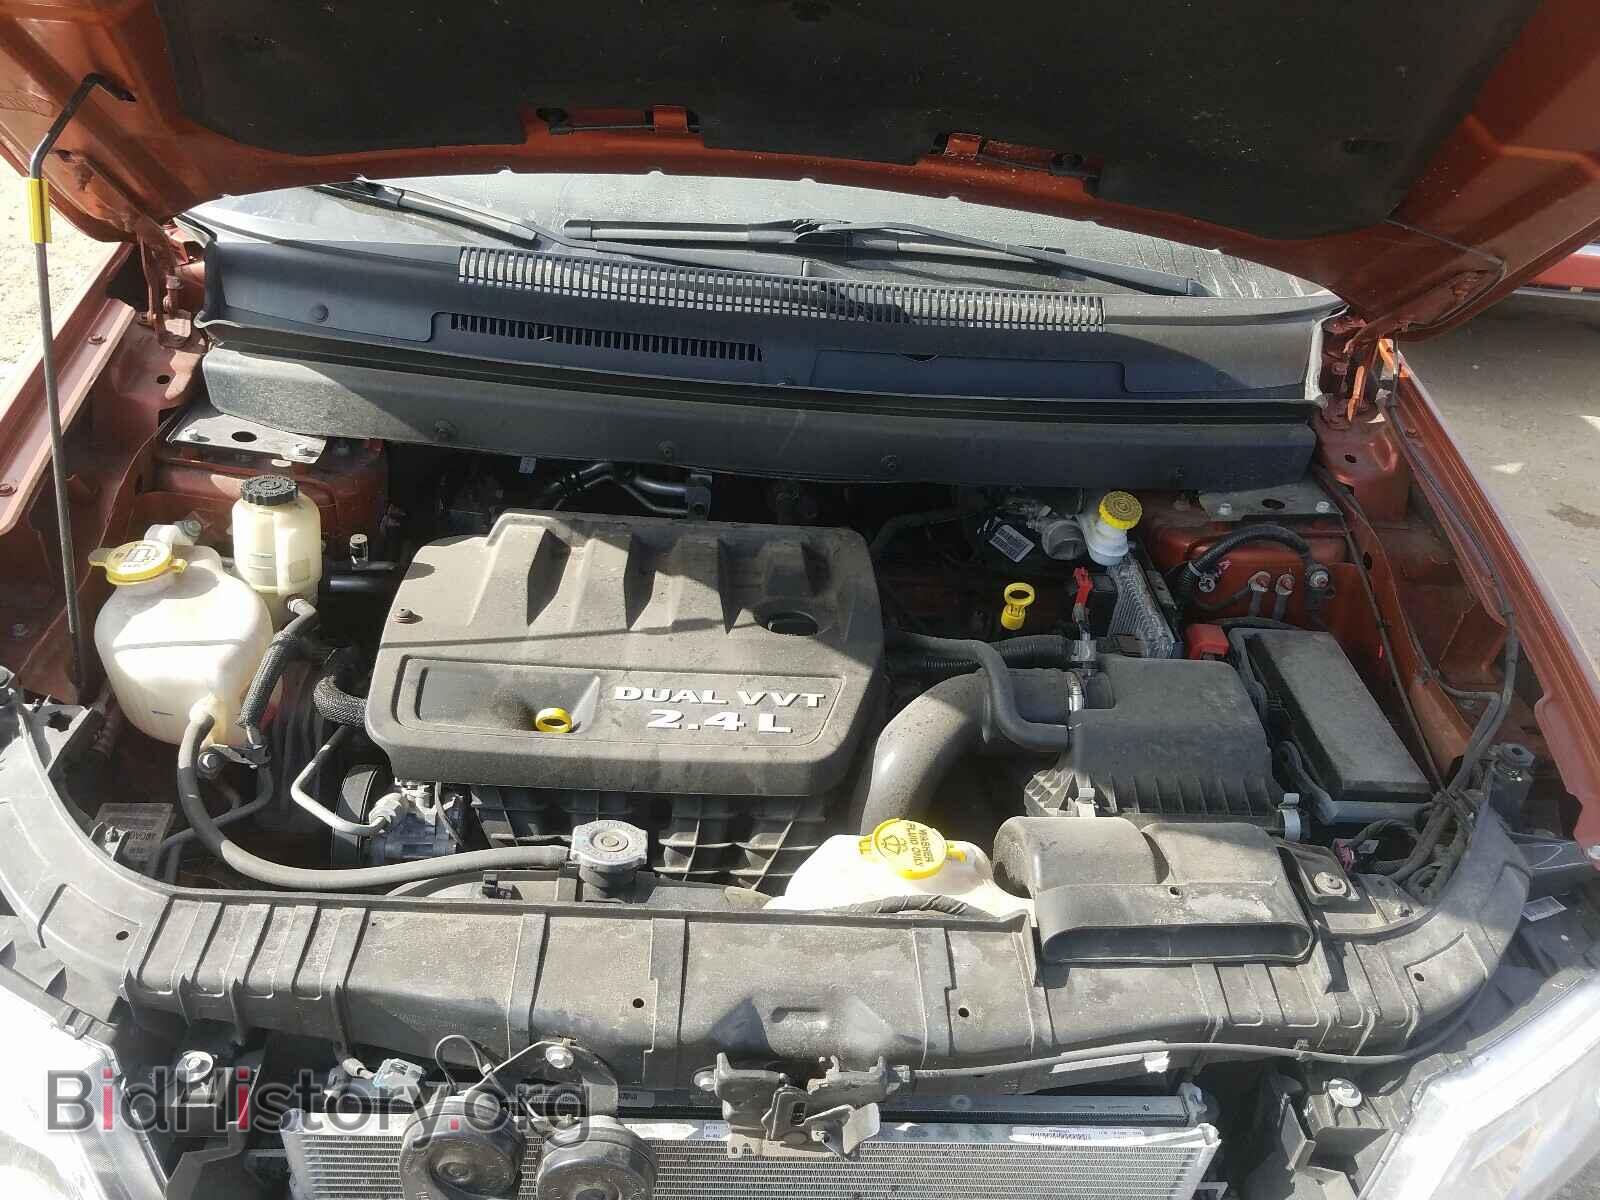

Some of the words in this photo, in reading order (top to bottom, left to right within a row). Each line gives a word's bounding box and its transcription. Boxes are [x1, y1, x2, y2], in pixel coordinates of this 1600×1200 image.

[615, 686, 729, 705] DUAL
[737, 689, 826, 708] VVT
[906, 822, 920, 846] FLUID
[919, 828, 935, 863] WASHER
[911, 846, 923, 867] ONLY
